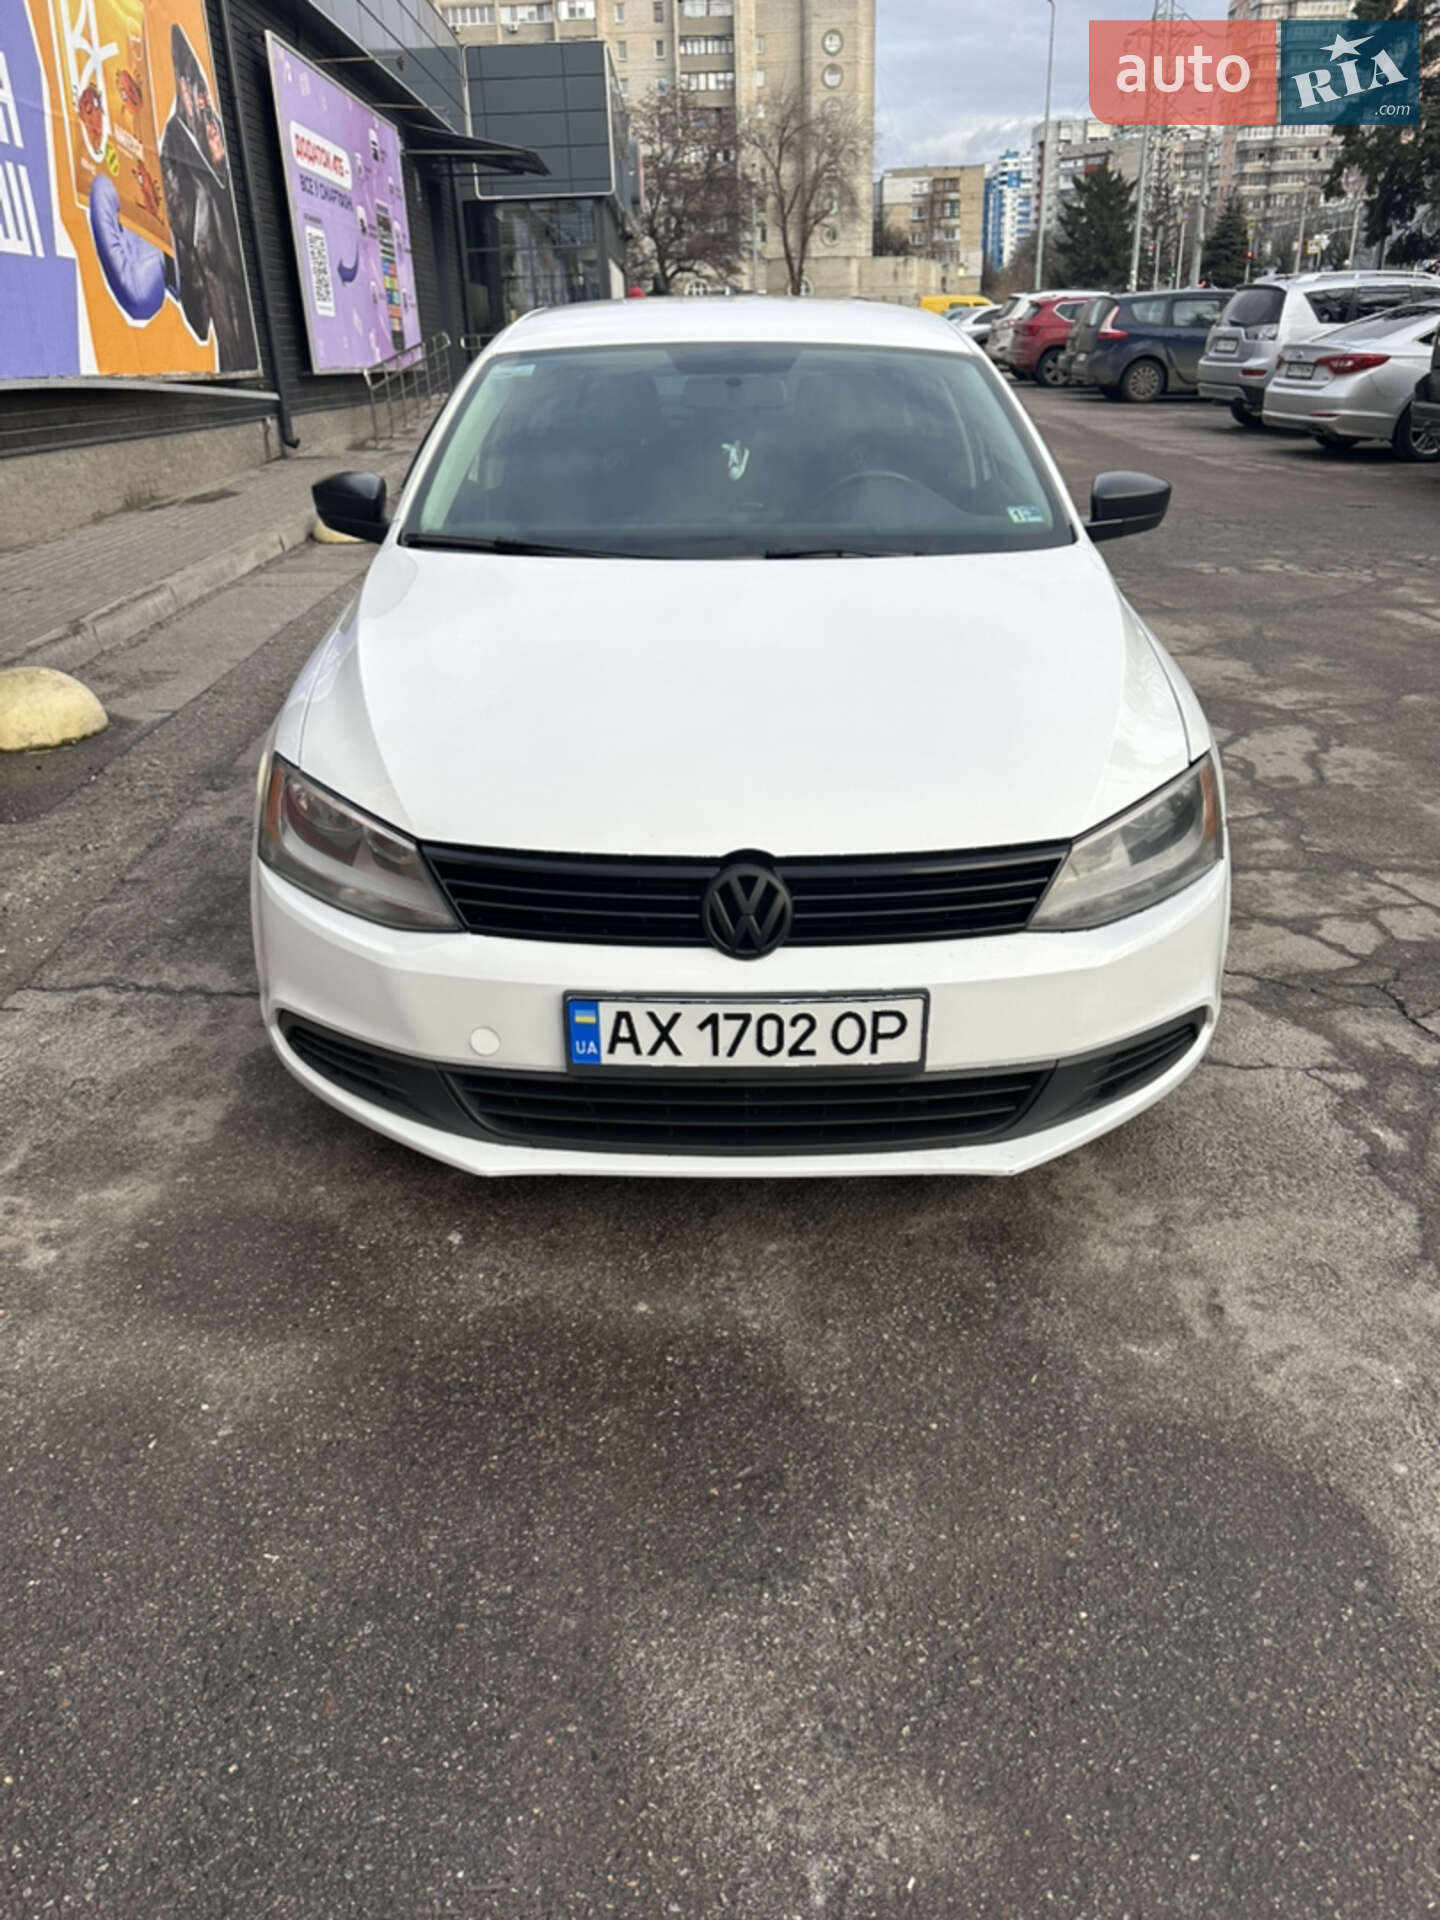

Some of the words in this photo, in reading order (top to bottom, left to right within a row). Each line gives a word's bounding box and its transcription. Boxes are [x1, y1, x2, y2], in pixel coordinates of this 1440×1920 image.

[575, 1040, 598, 1055] UA
[606, 1010, 683, 1056] AX
[696, 1012, 817, 1058] 1702
[830, 1010, 908, 1055] OP
